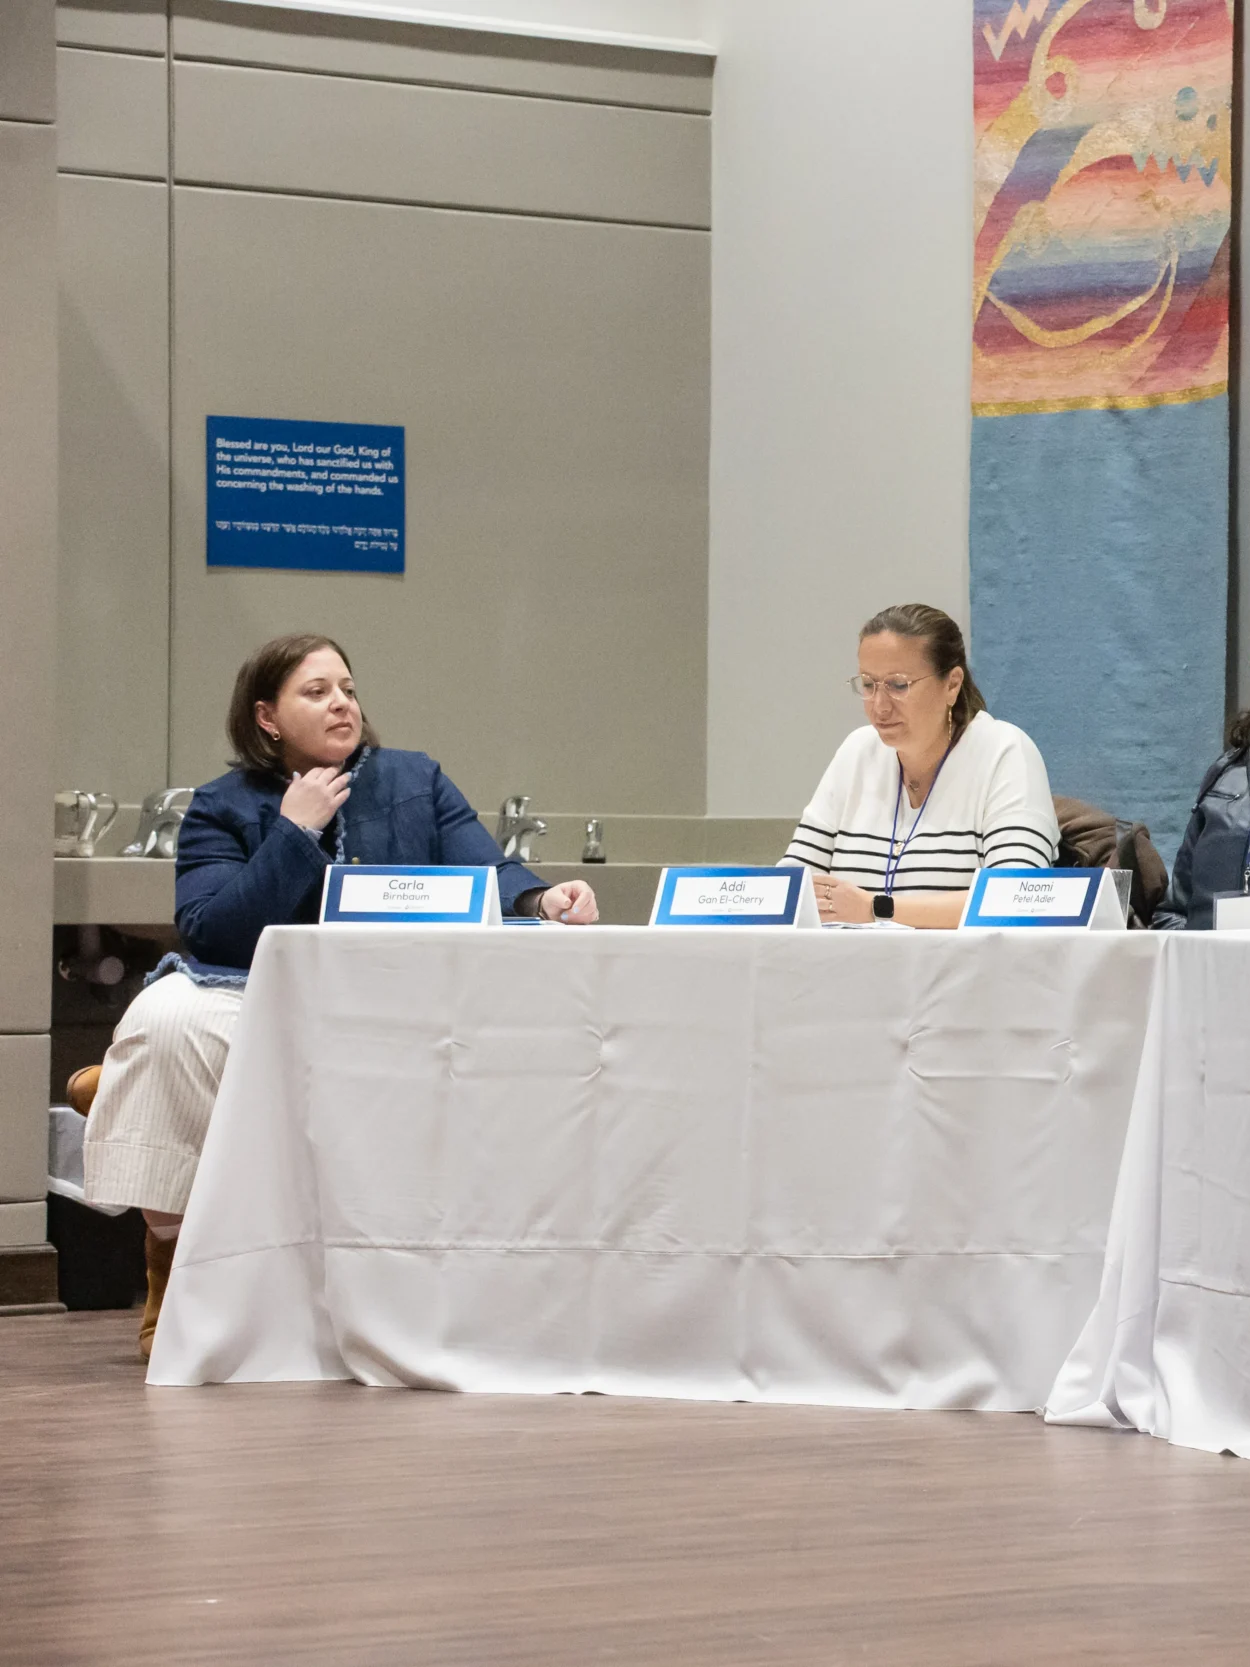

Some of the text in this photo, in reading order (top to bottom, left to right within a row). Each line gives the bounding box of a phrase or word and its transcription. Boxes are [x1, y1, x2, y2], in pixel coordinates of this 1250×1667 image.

[216, 438, 391, 459] Blessed are you, Lord our God, King of
[216, 451, 394, 470] the universe, who has sanctified us with
[216, 464, 399, 484] His commandments, and commanded us
[216, 478, 384, 496] concerning the washing of the hands.
[388, 879, 424, 891] Carla
[719, 880, 747, 892] Addi
[1019, 881, 1055, 892] Naomi
[382, 891, 430, 901] Birnbaum
[697, 894, 764, 906] Gan El-Cherry
[1012, 894, 1055, 904] Petel Adler
